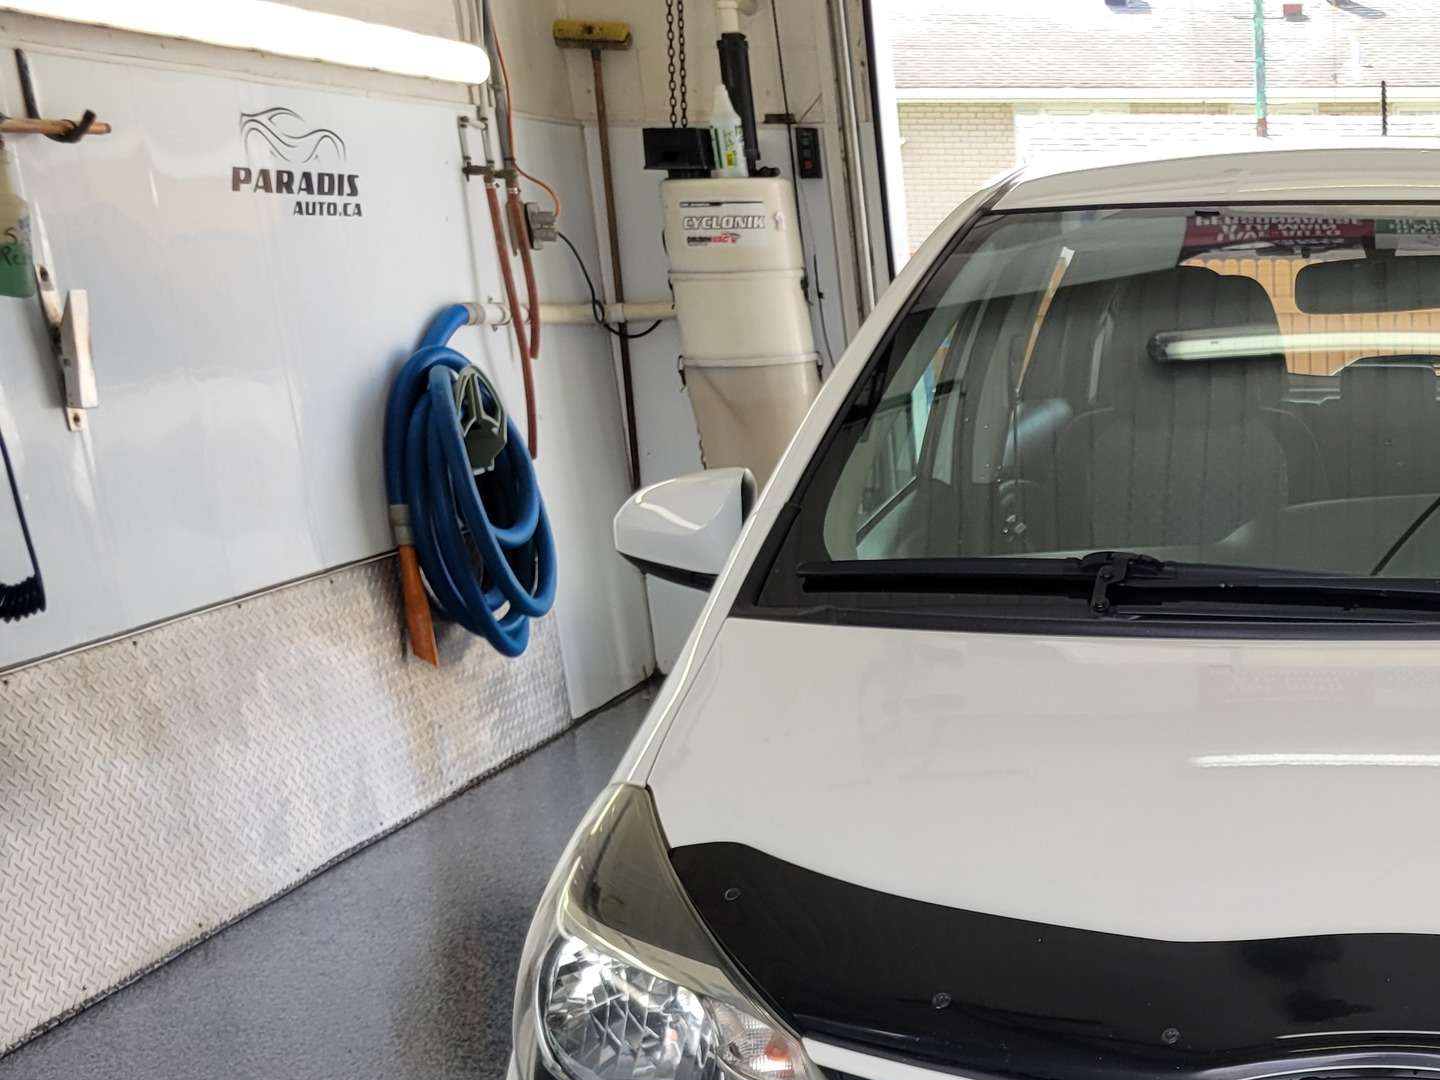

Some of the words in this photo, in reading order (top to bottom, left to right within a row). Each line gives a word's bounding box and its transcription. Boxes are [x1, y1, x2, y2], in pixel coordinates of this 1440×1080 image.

[231, 166, 359, 197] PARADIS
[292, 200, 362, 217] AUTO.CA
[683, 215, 766, 230] CYCLONIK
